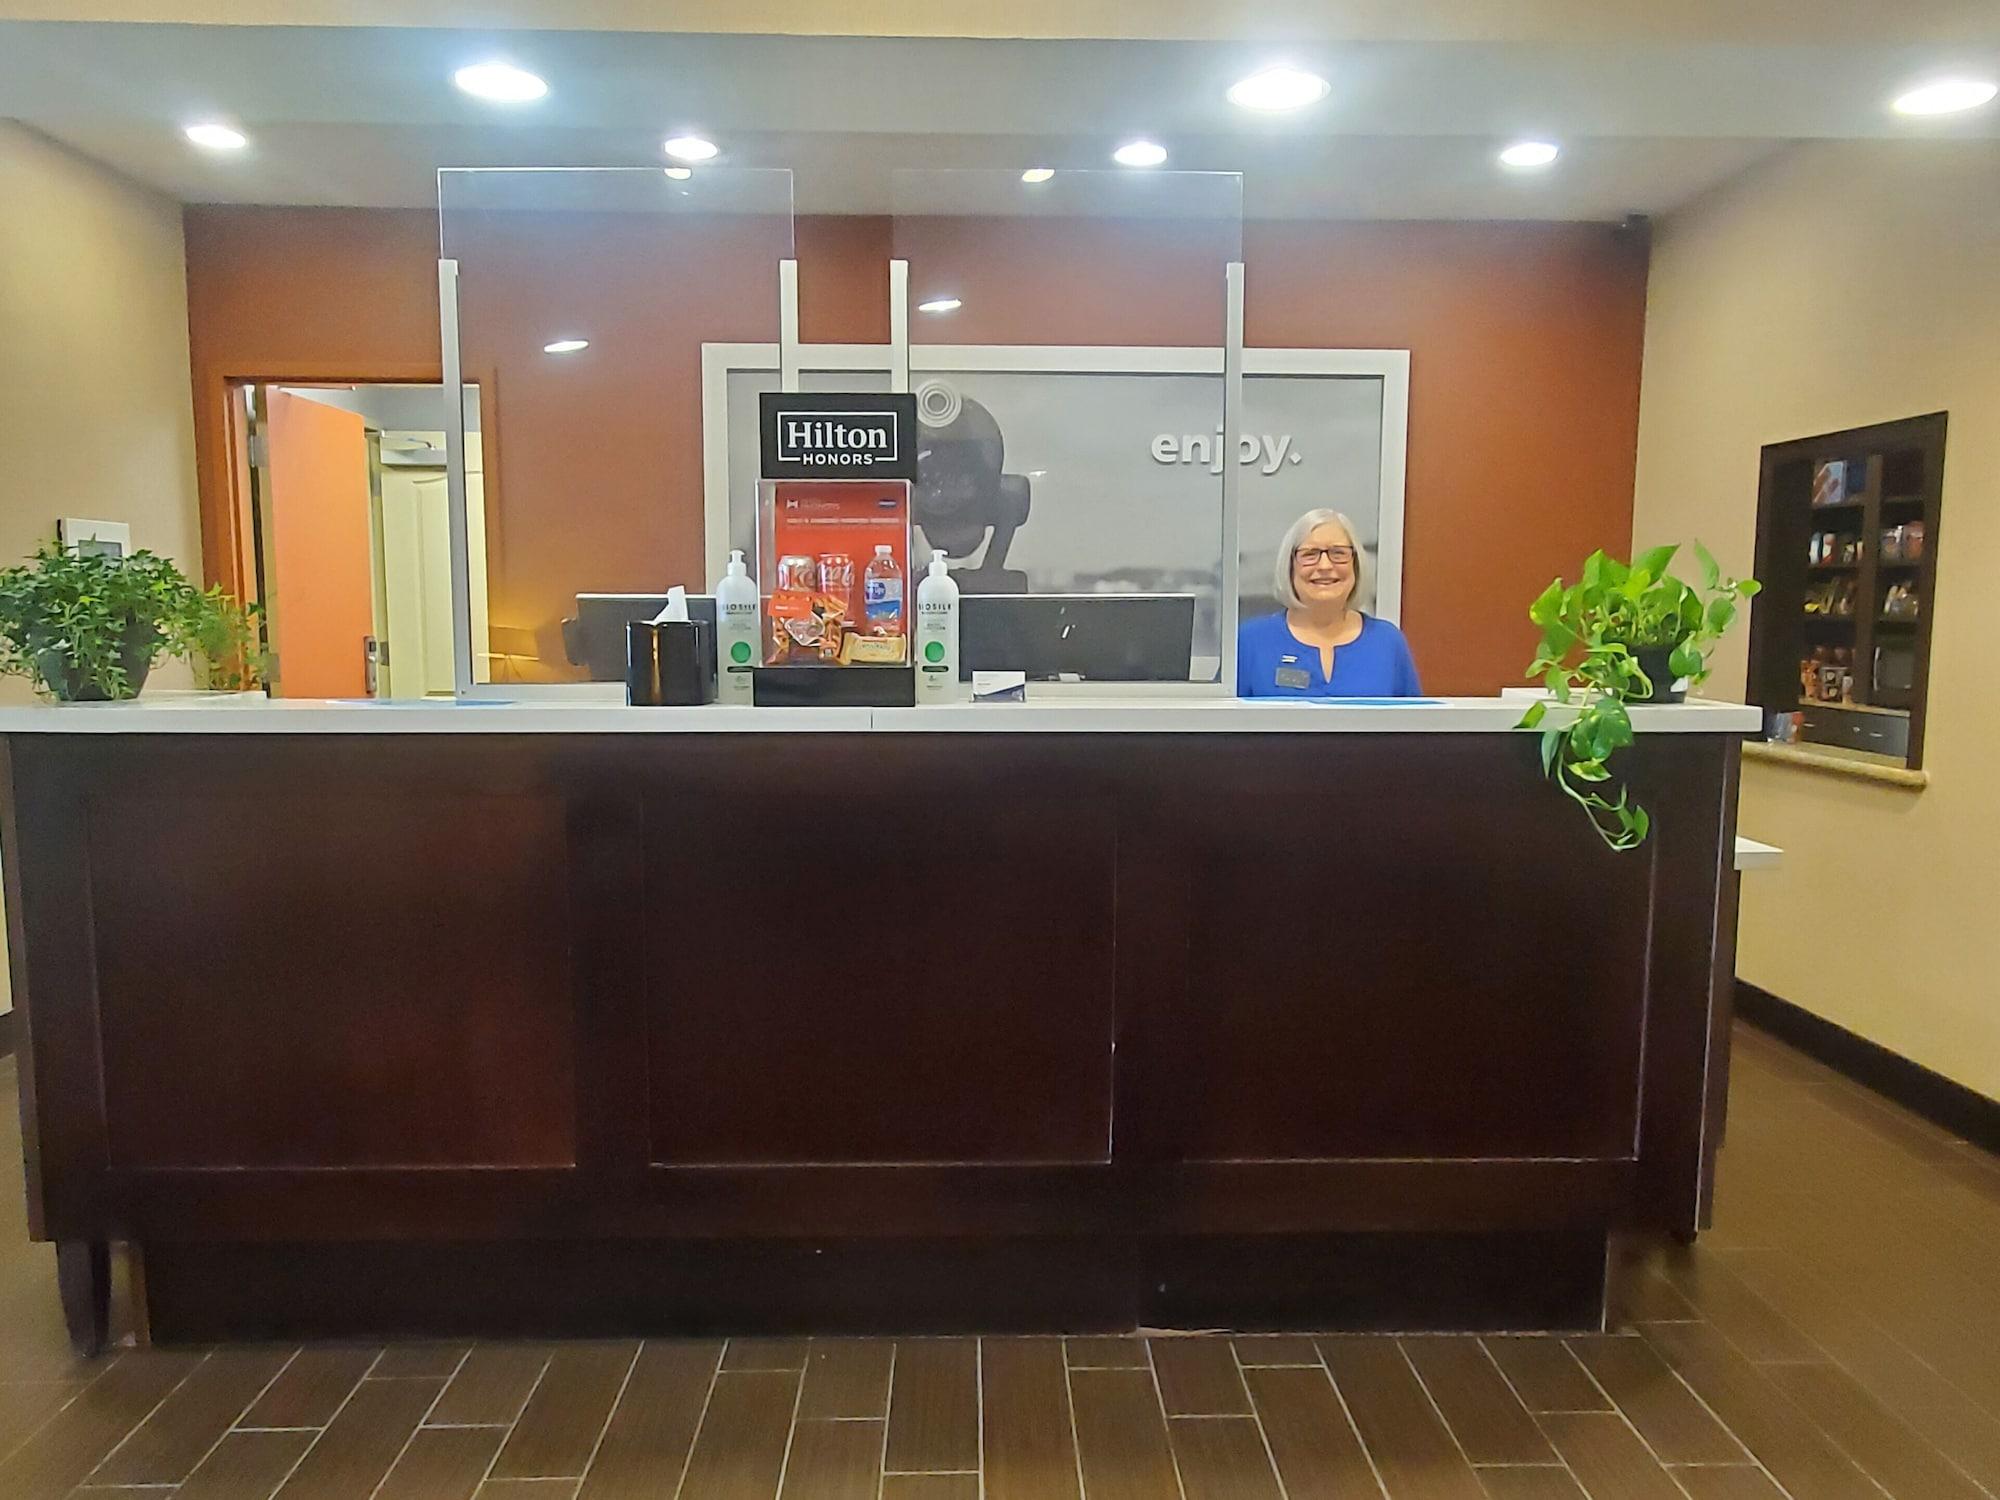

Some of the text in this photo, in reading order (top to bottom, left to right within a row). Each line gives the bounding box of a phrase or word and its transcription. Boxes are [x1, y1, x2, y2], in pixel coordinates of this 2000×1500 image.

[787, 421, 888, 449] Hilton
[1151, 424, 1302, 474] enjoy.
[802, 453, 873, 466] HONORS
